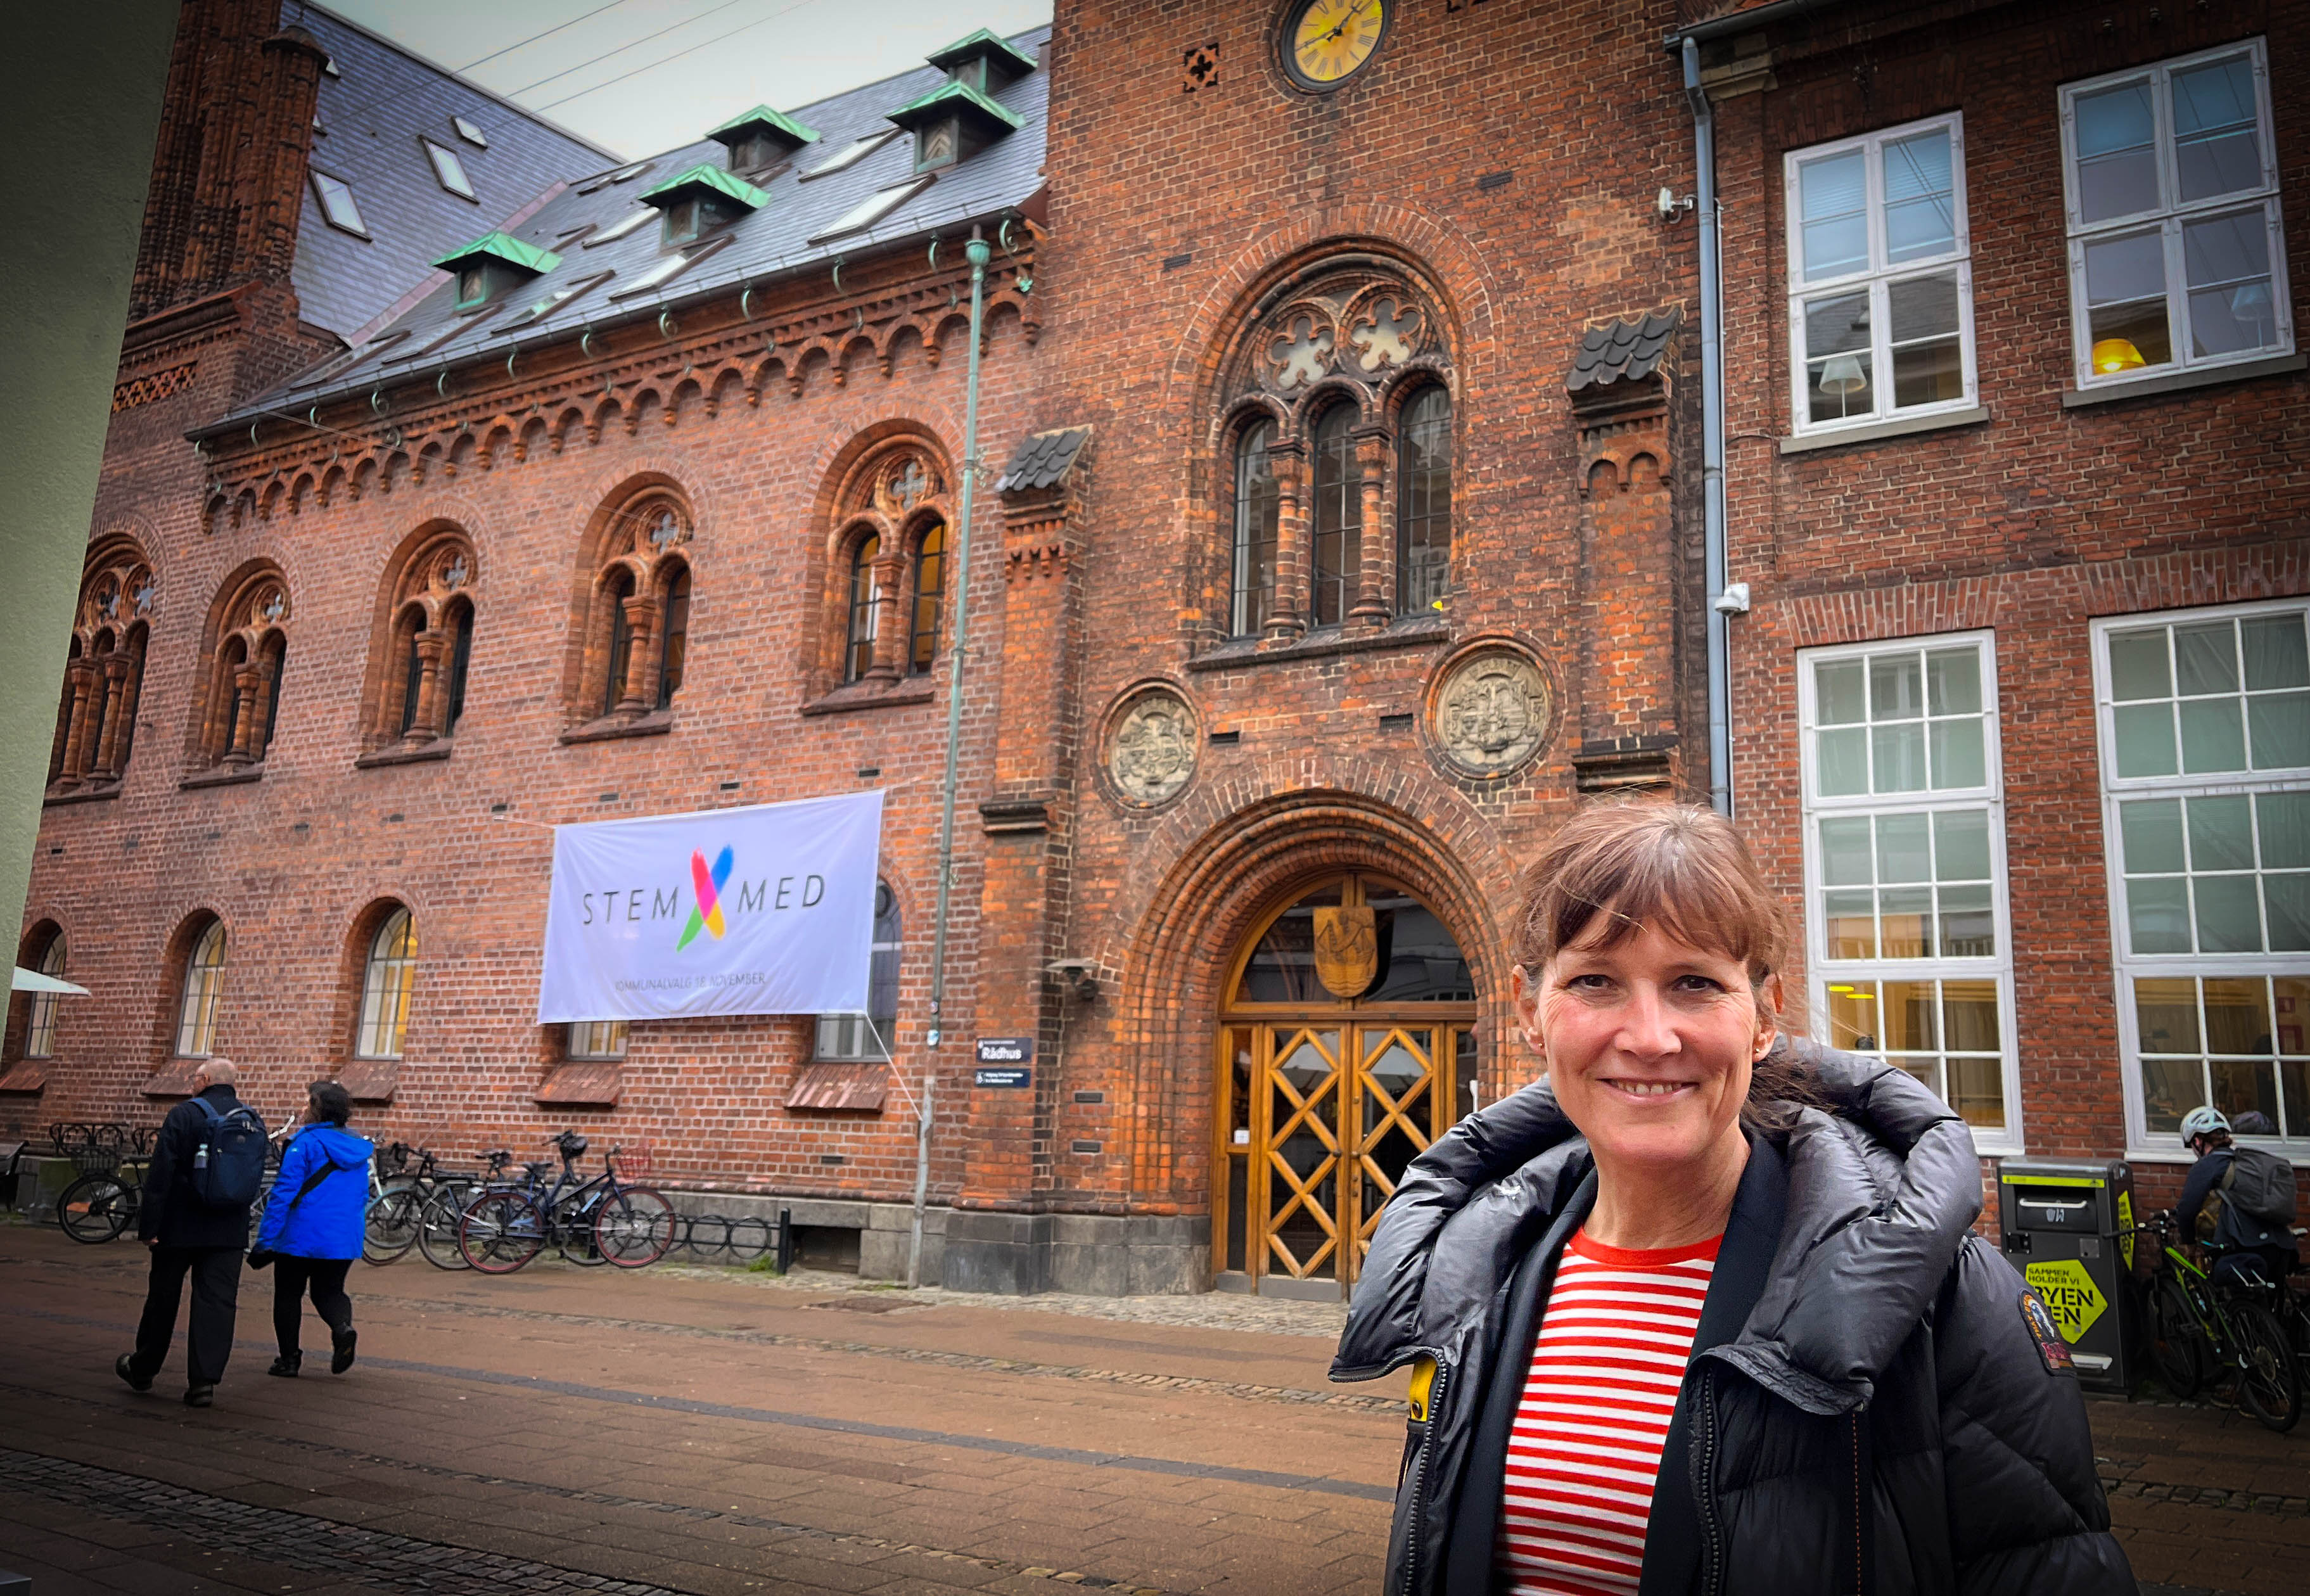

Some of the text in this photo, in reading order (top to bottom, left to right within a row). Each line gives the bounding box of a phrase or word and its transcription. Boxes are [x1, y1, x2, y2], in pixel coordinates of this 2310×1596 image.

[582, 886, 679, 925] STEM
[737, 874, 825, 914] MED
[2047, 1306, 2081, 1325] EN
